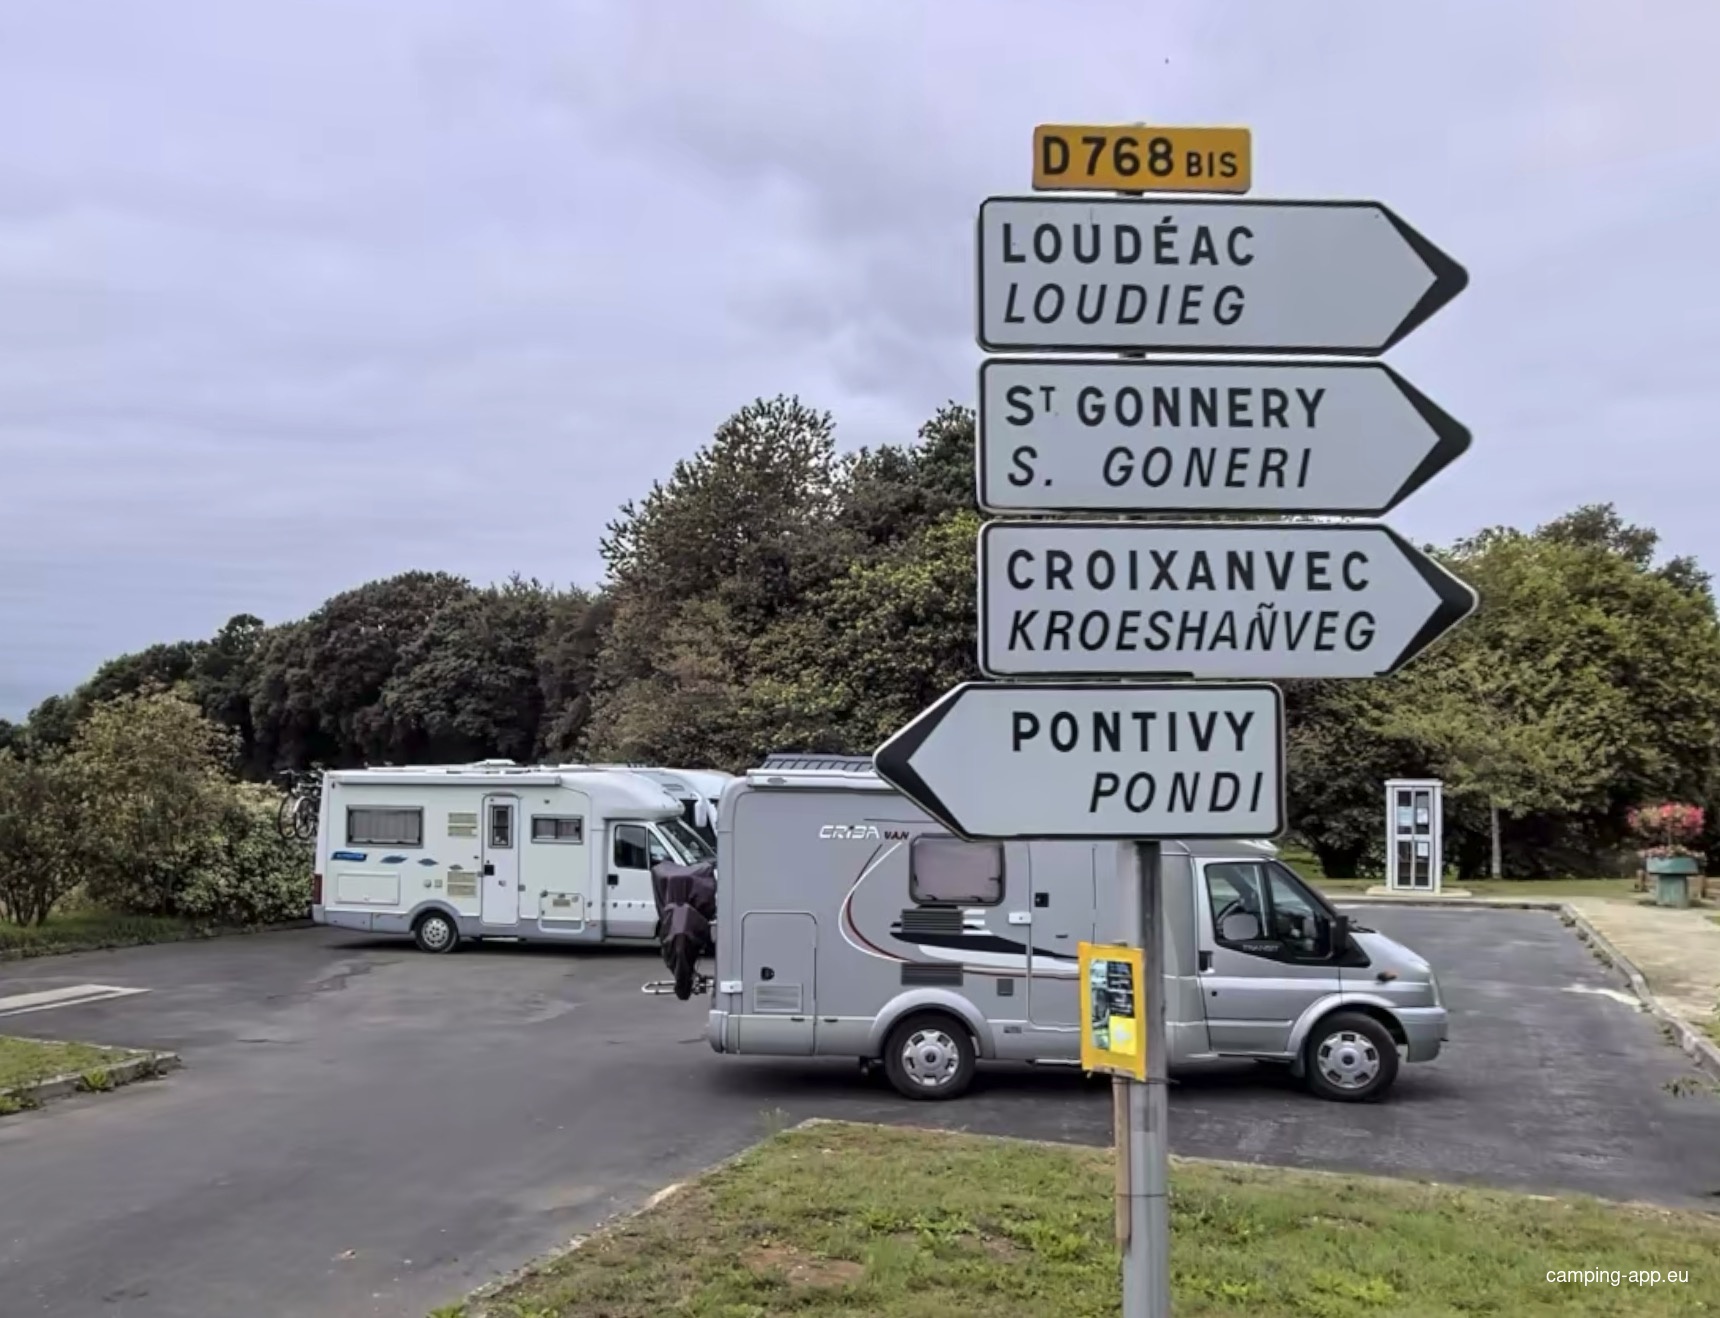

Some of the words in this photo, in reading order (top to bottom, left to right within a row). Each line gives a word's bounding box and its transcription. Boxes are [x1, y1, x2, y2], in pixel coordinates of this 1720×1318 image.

[1186, 151, 1238, 178] BIS
[1002, 215, 1255, 267] LOUDÉAC
[1004, 282, 1246, 326] LOUDIEG
[1077, 385, 1326, 429] GONNERY
[1007, 445, 1053, 488] S.
[1102, 446, 1312, 489] GONERI
[1006, 548, 1370, 592] CROIXANVEC
[1007, 602, 1377, 652] KROESHAÑVEG
[1012, 710, 1255, 753] PONTIVY
[1089, 771, 1264, 814] PONDI
[884, 831, 910, 841] VAN
